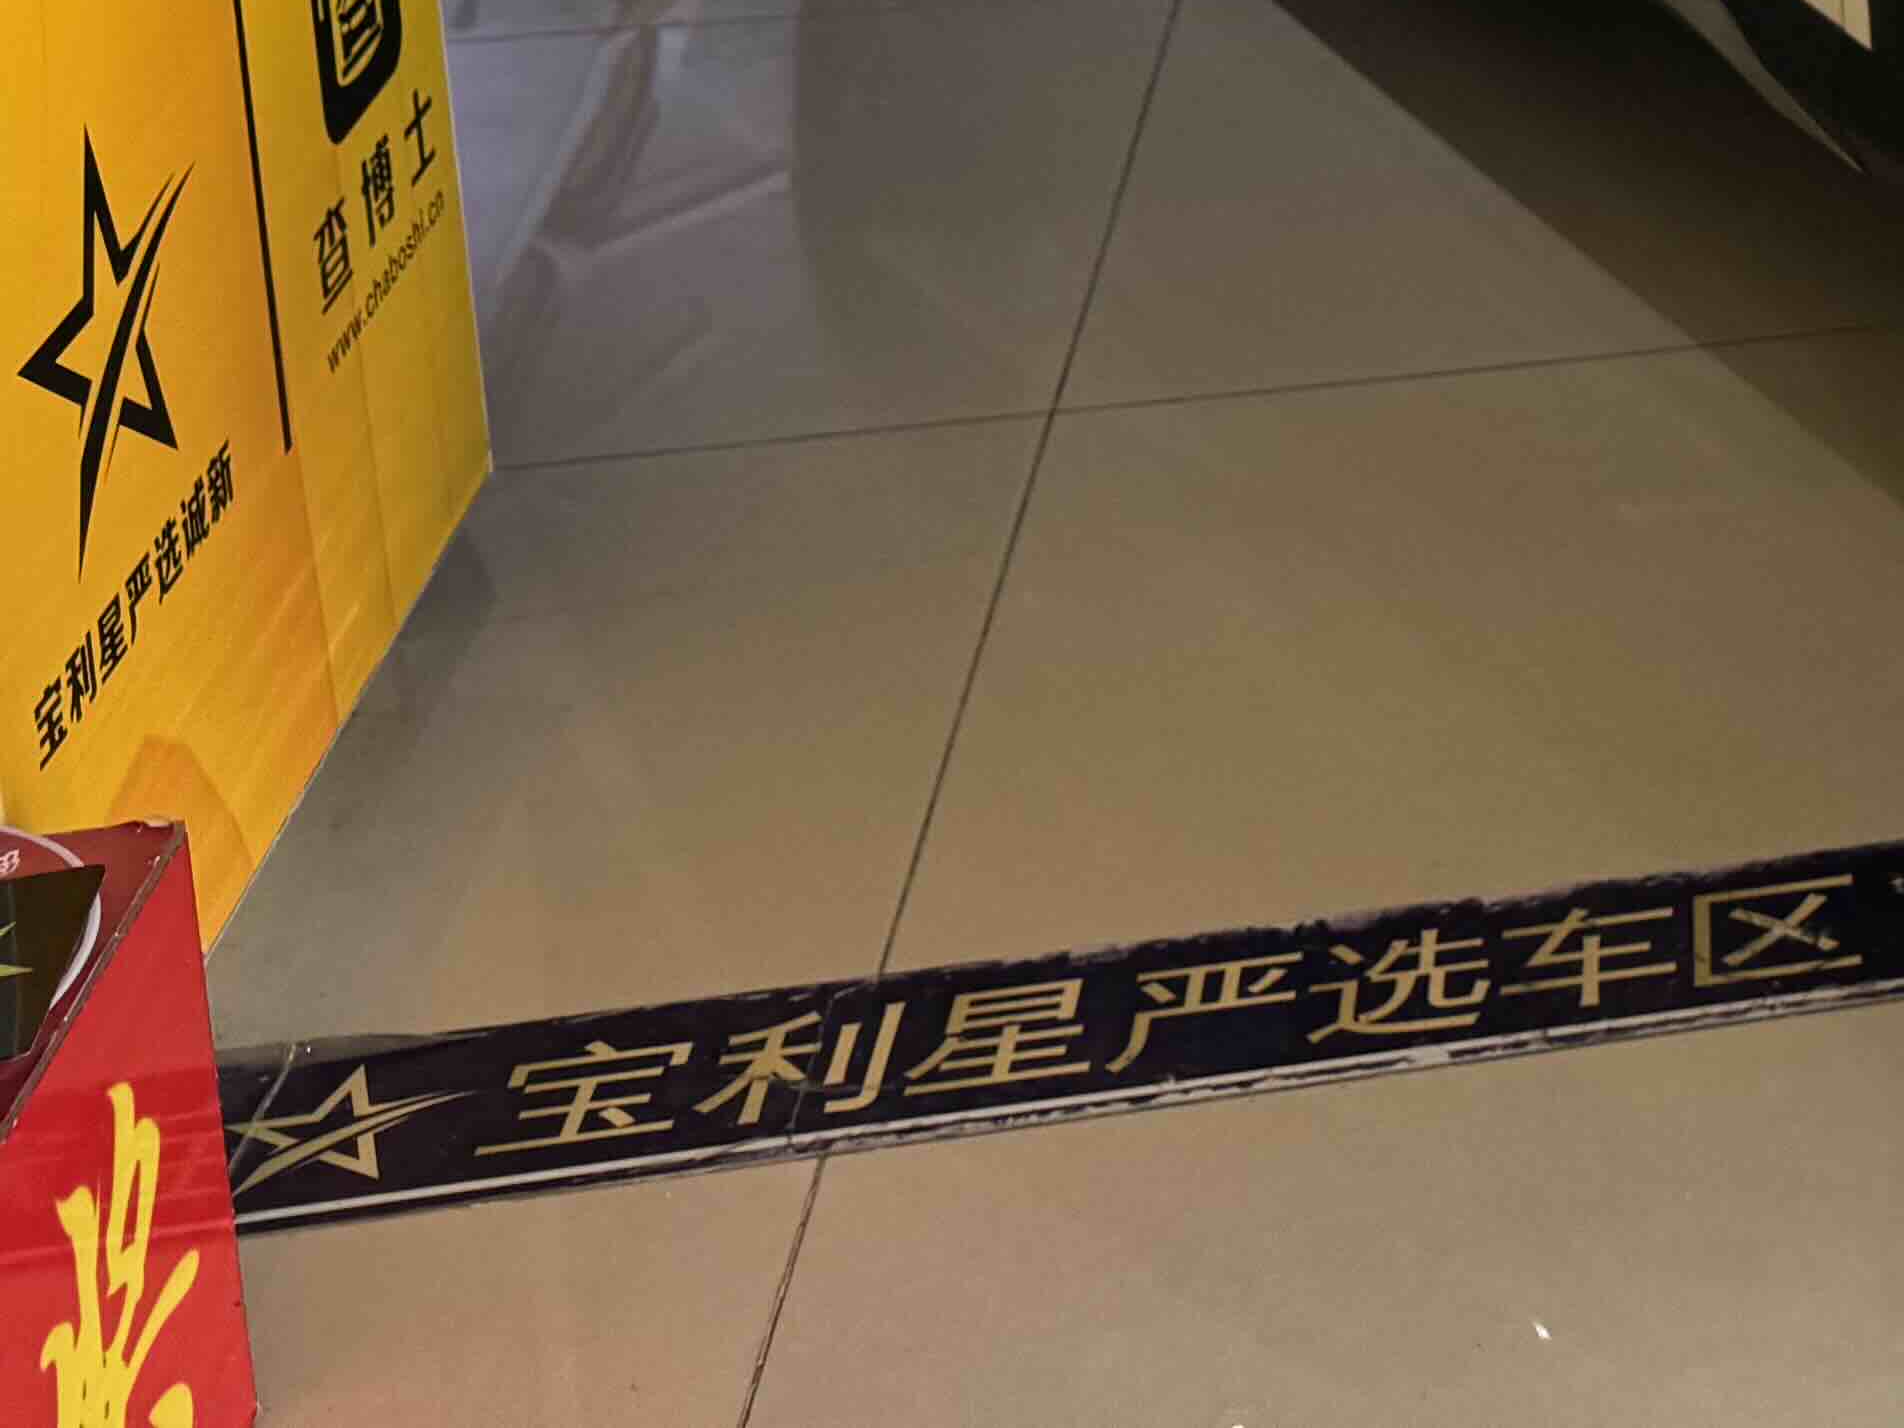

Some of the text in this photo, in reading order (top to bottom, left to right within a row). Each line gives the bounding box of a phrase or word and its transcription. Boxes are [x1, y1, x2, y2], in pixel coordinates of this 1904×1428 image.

[314, 89, 435, 315] 查博士
[327, 189, 444, 373] www.chaboshi.cn
[34, 439, 234, 772] 宝利星严选诚新
[476, 873, 1862, 1157] 宝利星严选车区
